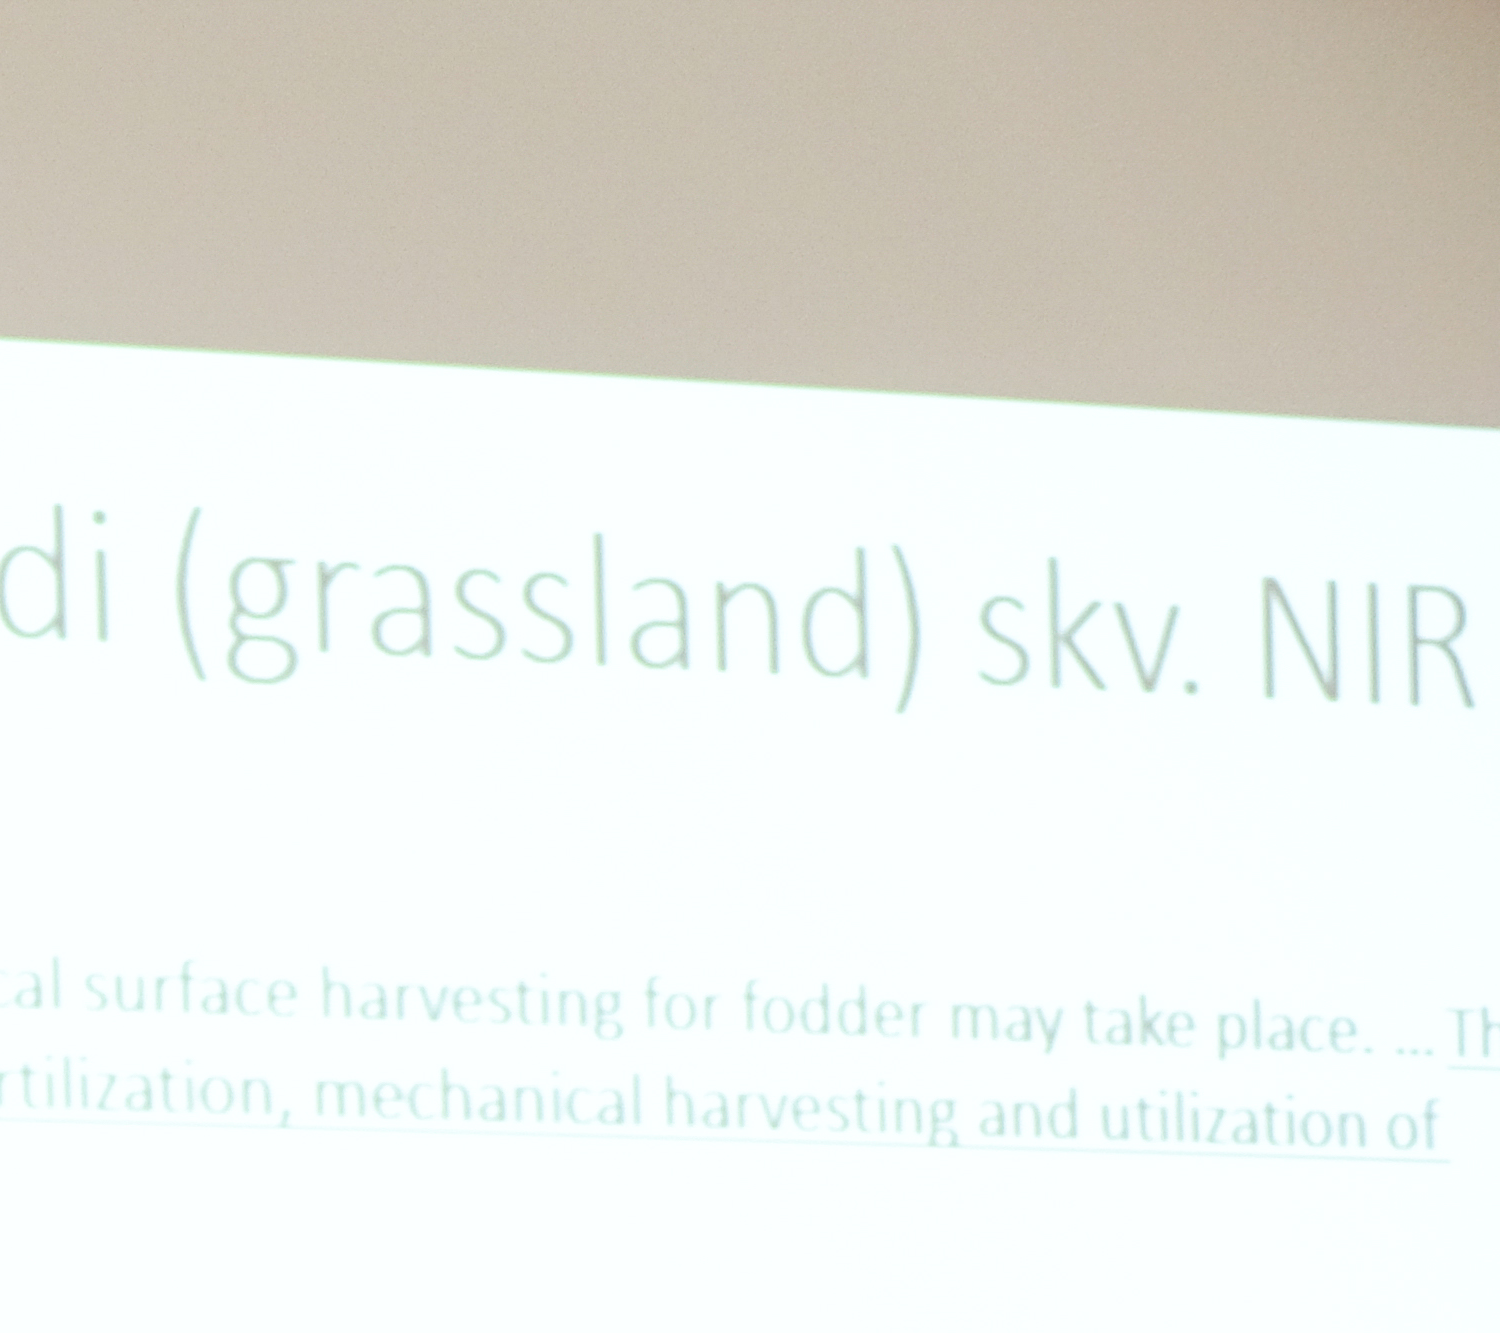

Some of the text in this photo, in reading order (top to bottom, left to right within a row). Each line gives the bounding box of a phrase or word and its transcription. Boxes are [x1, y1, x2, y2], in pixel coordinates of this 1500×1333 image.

[174, 505, 924, 716] (grassland)
[977, 555, 1201, 697] skv.
[1260, 574, 1477, 710] NIR
[83, 958, 301, 1018] surface
[319, 964, 627, 1042] harvesting
[642, 974, 719, 1032] for
[740, 977, 927, 1040] fodder
[948, 1001, 1067, 1057] may
[1080, 991, 1199, 1050] take
[1214, 995, 1375, 1063] place.
[313, 1066, 644, 1128] mechanical
[663, 1073, 966, 1151] harvesting
[976, 1085, 1082, 1142] and
[1098, 1087, 1370, 1151] utilization
[1383, 1095, 1441, 1153] of
